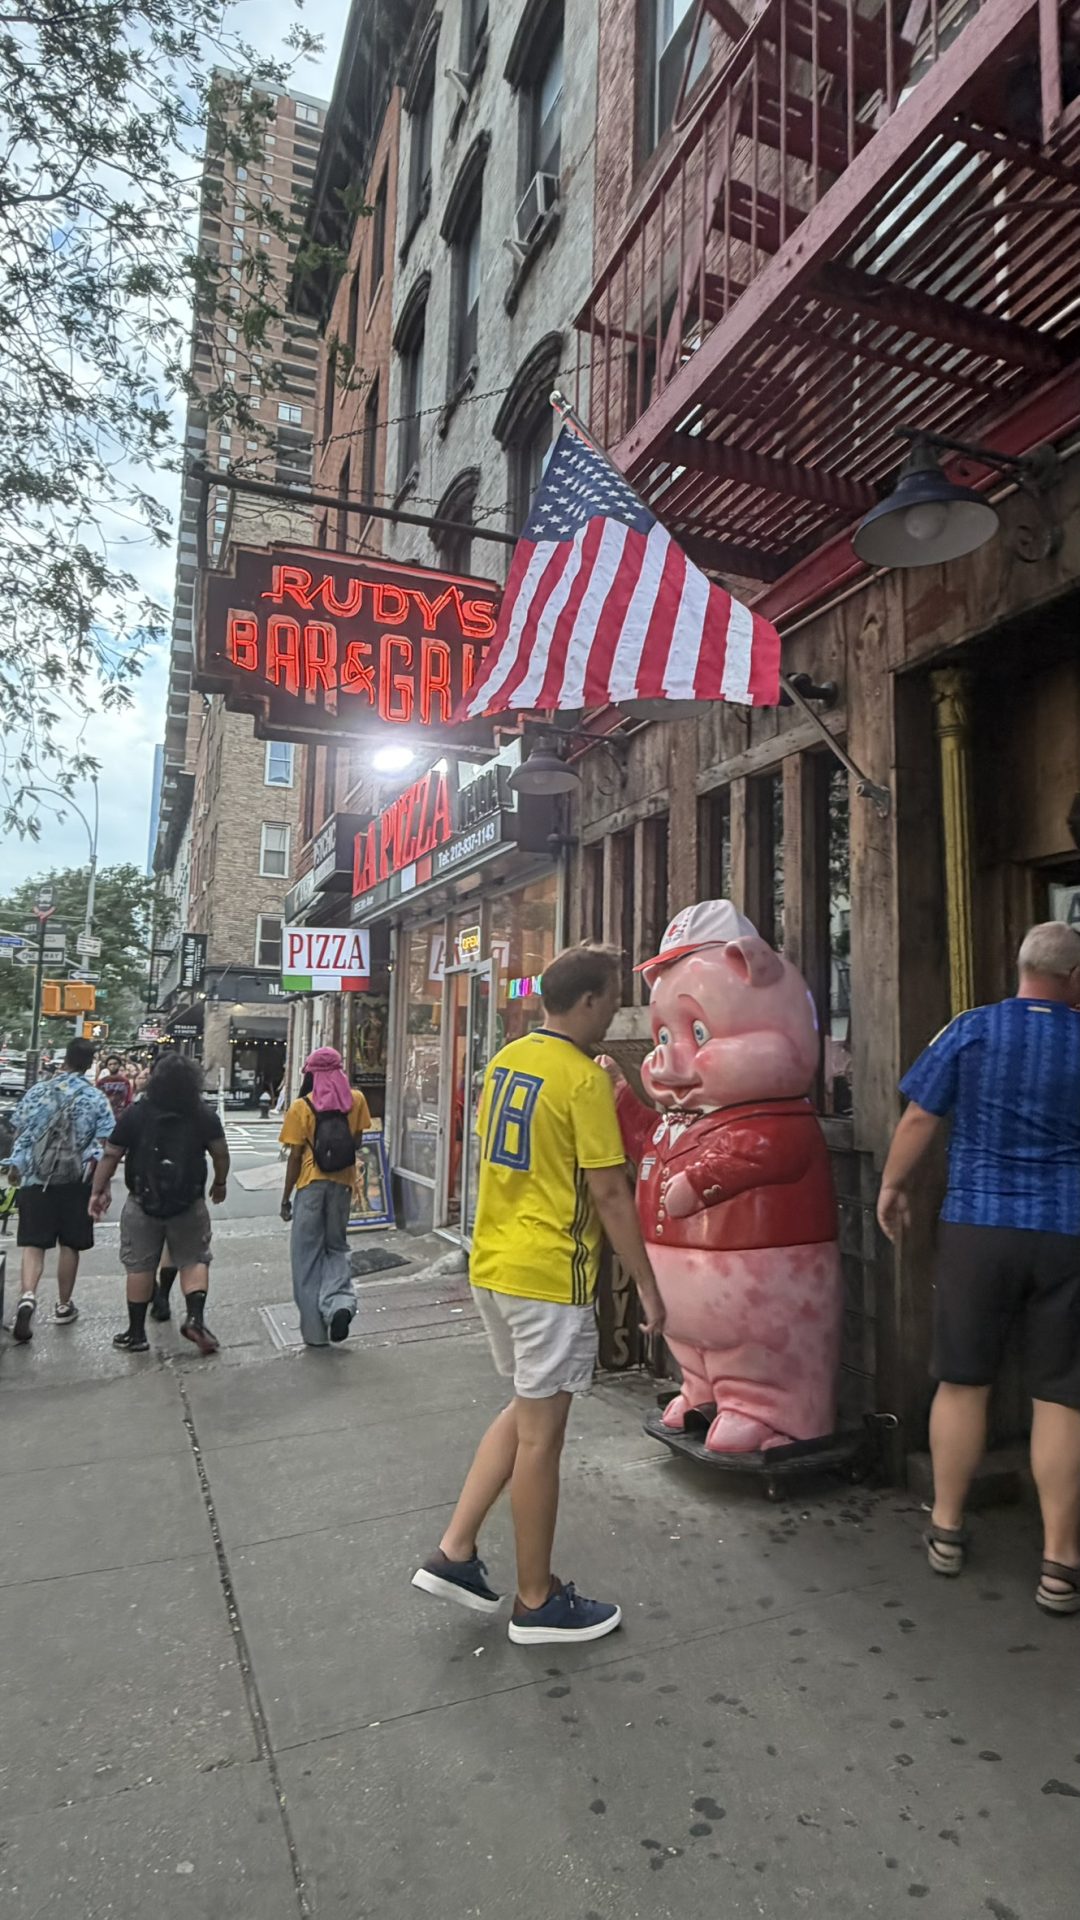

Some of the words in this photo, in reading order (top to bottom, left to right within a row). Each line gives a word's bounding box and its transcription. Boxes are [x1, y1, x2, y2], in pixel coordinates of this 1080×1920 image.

[262, 565, 498, 639] RUDY'S
[352, 820, 377, 898] LA
[379, 770, 452, 883] PIZZA
[450, 822, 495, 863] 212-837-1143
[22, 952, 36, 960] ONE
[44, 952, 60, 960] WAY
[287, 933, 365, 970] PIZZA
[462, 935, 478, 950] OPEN
[484, 1067, 545, 1171] 18
